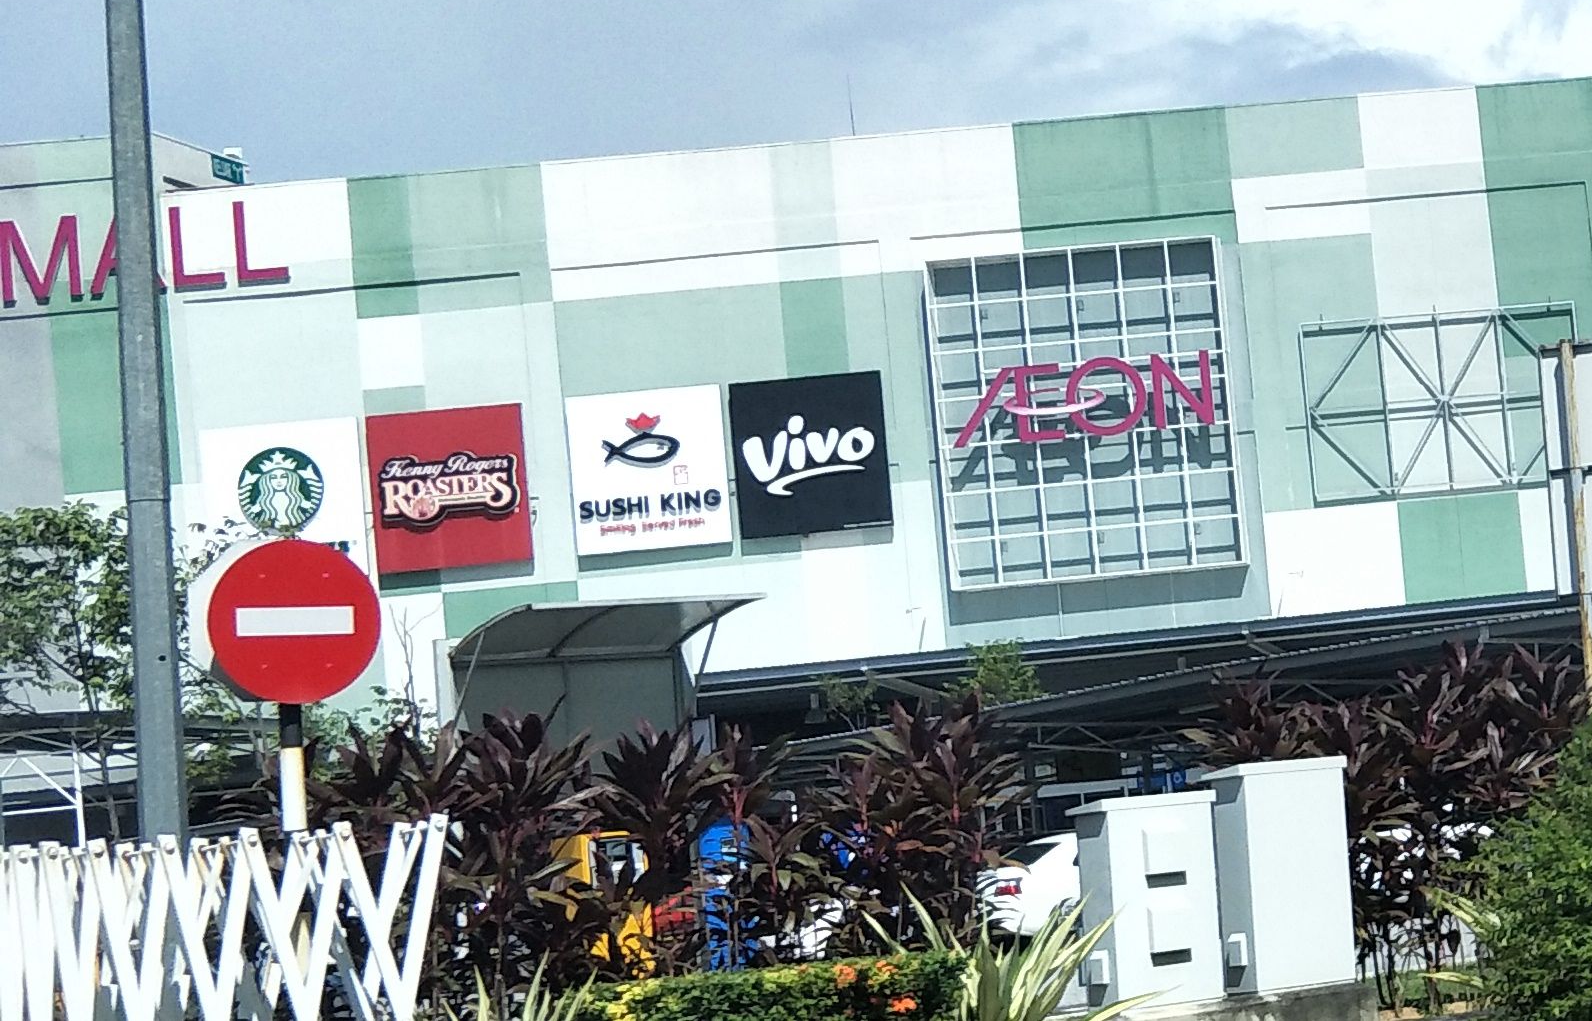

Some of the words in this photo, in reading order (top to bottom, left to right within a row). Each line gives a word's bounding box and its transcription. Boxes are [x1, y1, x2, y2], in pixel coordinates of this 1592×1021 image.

[381, 459, 443, 479] Kenny
[444, 454, 509, 476] Rogers
[381, 471, 512, 519] ROASTERS
[579, 495, 650, 520] SUSHI
[660, 488, 722, 512] KING
